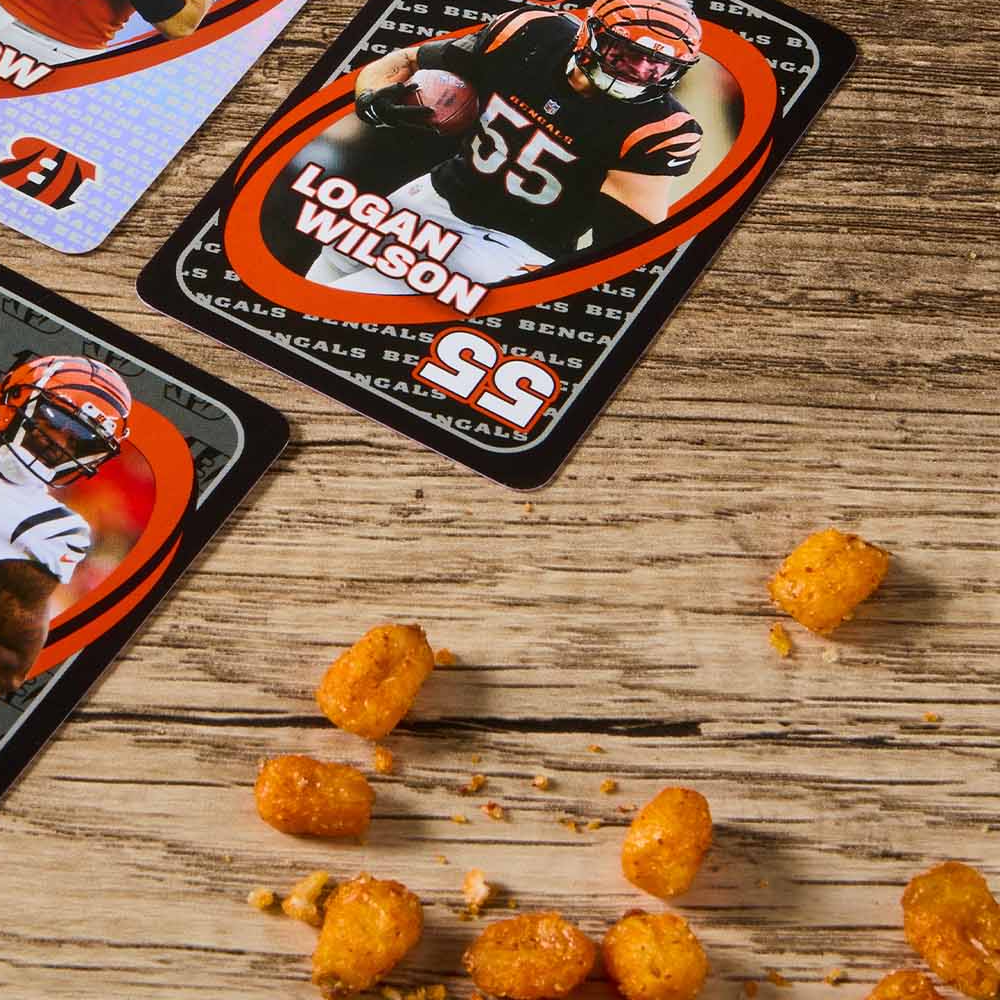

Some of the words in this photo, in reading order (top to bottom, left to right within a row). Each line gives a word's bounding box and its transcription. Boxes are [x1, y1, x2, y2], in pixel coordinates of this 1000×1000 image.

[471, 91, 578, 205] 55
[291, 162, 463, 263] LOGAN
[295, 200, 489, 315] WILSON
[415, 328, 558, 432] 55
